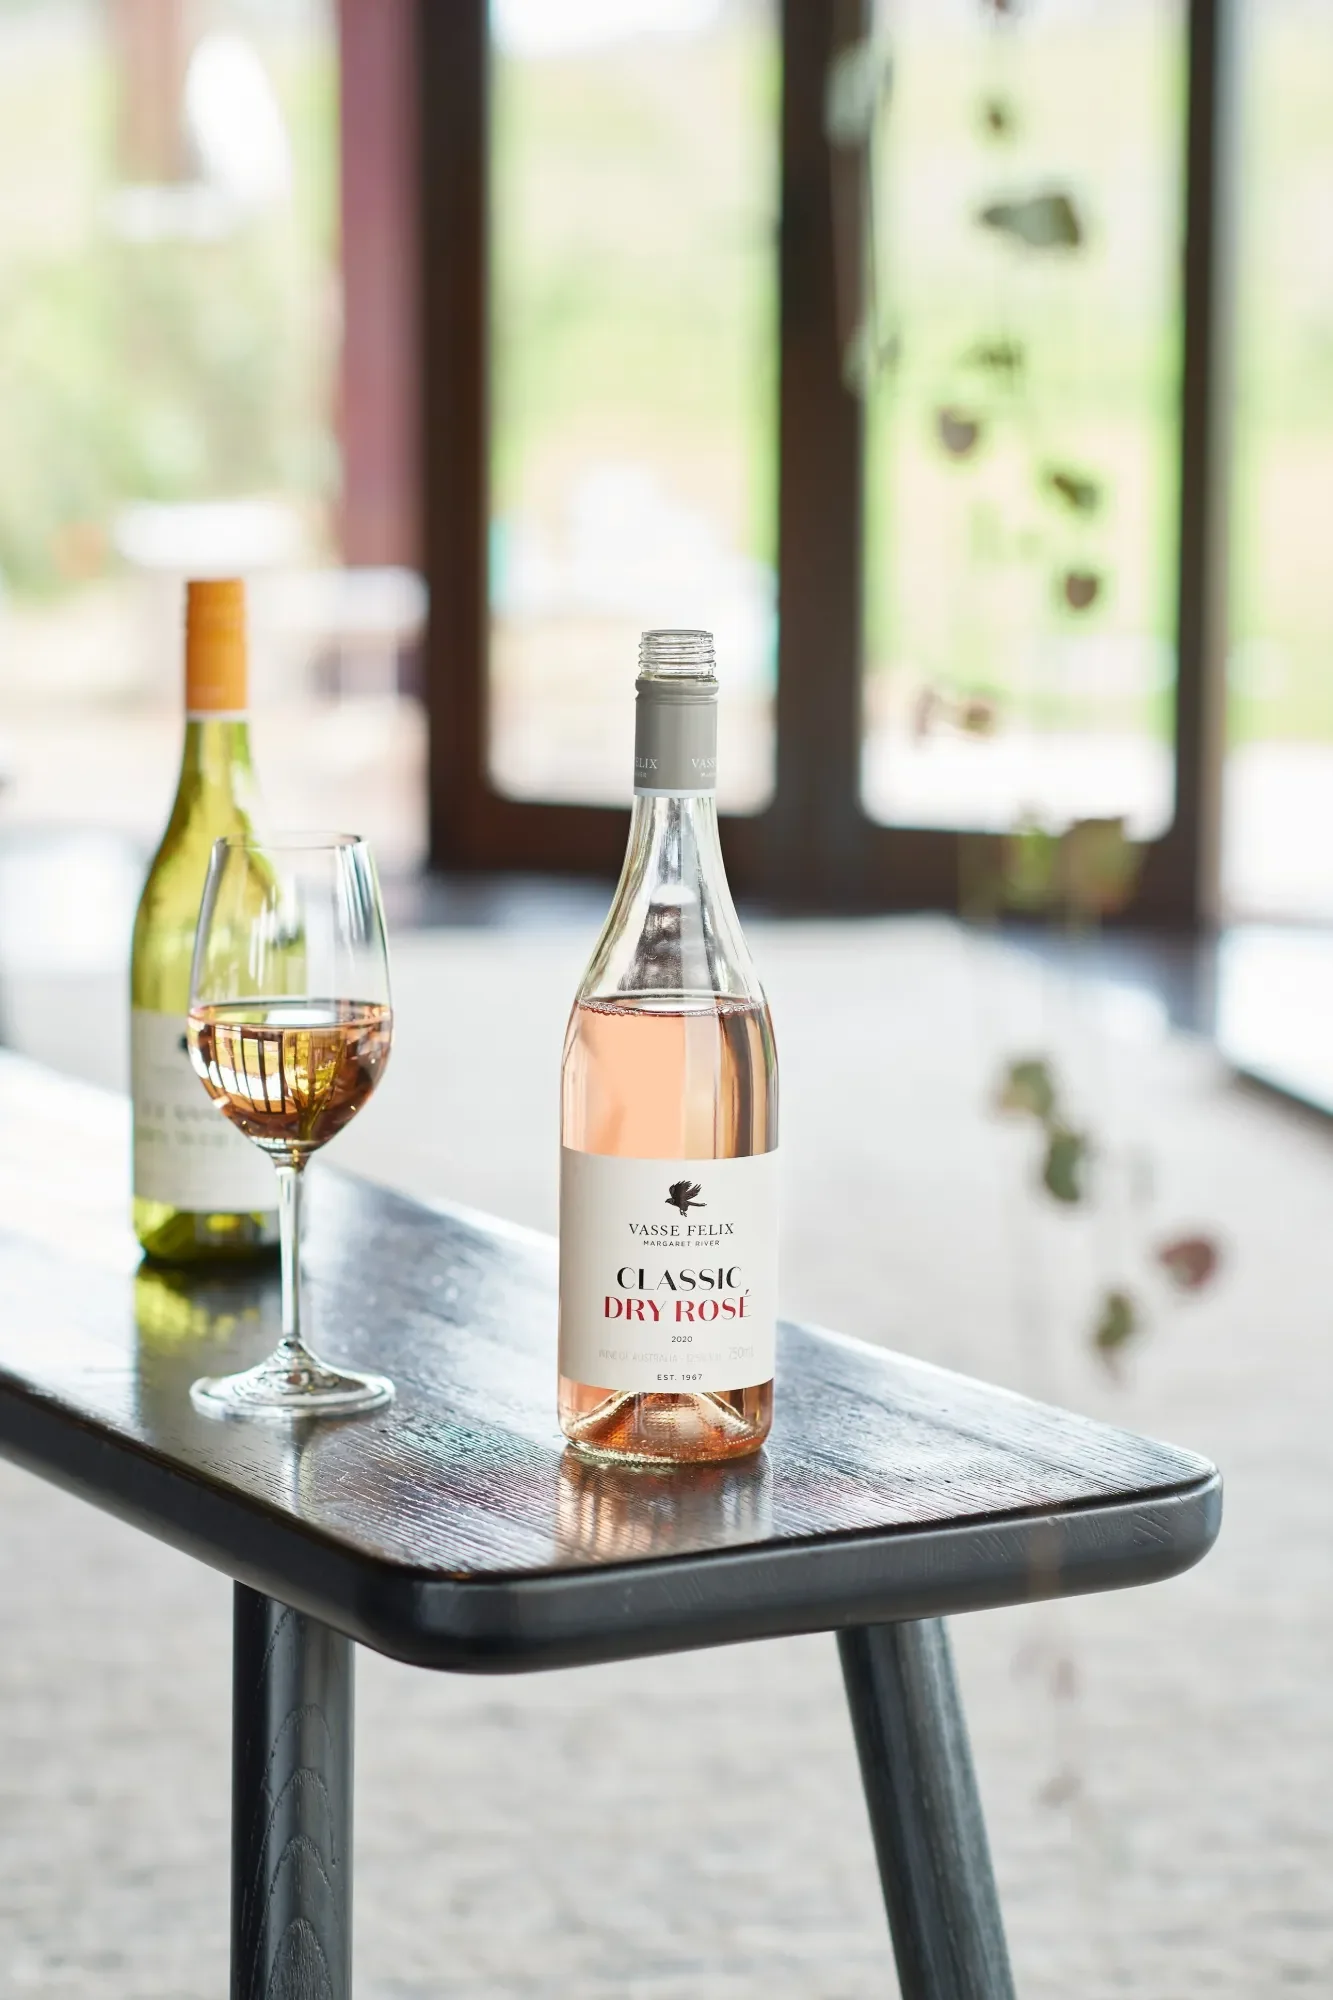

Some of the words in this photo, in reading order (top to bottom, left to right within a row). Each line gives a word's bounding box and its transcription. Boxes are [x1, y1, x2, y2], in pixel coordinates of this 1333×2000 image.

[635, 756, 658, 769] ELIX
[691, 757, 716, 769] VASS
[628, 1223, 681, 1236] VASSE
[686, 1222, 735, 1236] FELIX
[694, 1239, 720, 1247] RIVER
[616, 1266, 742, 1291] CLASSIC
[604, 1296, 667, 1322] DRY
[675, 1288, 752, 1322] ROSÉ
[671, 1335, 693, 1343] 2020
[632, 1351, 678, 1363] AUSTRALIA
[656, 1373, 678, 1381] EST.
[681, 1373, 703, 1381] 1967
